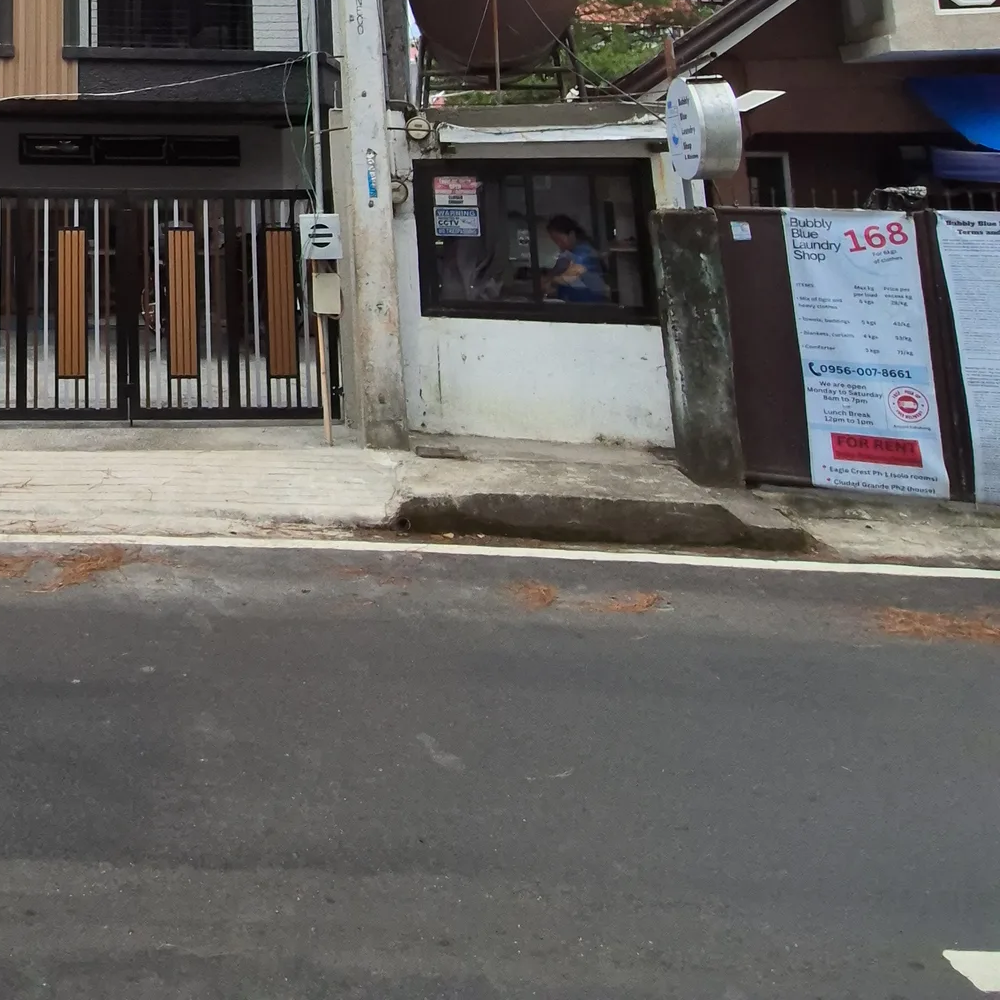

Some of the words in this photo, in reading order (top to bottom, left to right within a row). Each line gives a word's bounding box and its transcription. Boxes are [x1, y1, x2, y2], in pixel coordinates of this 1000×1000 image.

[790, 218, 832, 230] Bubbly
[791, 228, 818, 239] Blue
[844, 222, 908, 252] 168
[792, 239, 840, 252] Laundry
[794, 250, 826, 262] Shop
[820, 364, 912, 379] 0956-007-8661
[807, 387, 836, 396] Monday
[848, 390, 882, 398] Saturday
[837, 436, 869, 449] FOR
[873, 440, 915, 454] RENT
[834, 479, 860, 487] Ciudad
[862, 482, 889, 490] Grande
[907, 486, 936, 495] (house)
